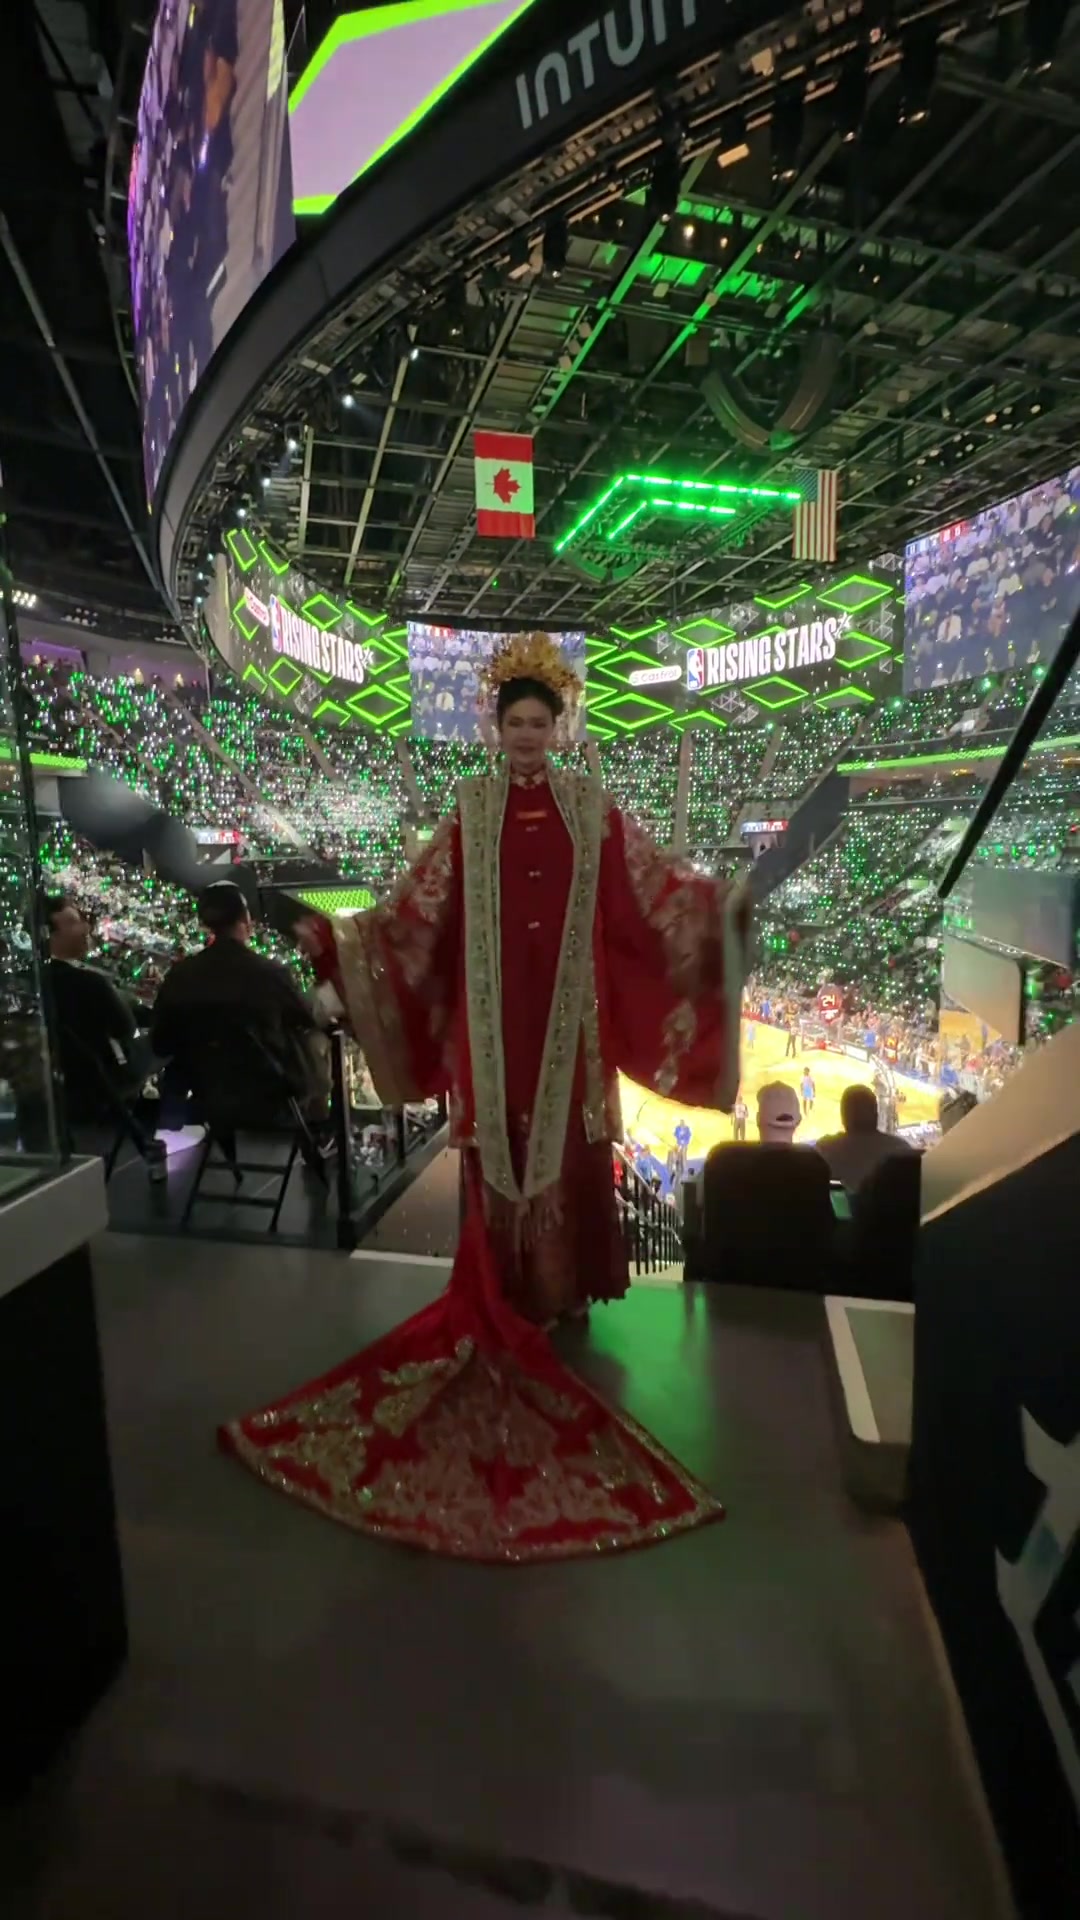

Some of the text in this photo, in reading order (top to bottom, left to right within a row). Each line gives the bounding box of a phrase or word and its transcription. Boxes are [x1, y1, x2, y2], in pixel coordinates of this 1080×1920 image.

[280, 604, 321, 670] RISING
[321, 630, 365, 683] STARS
[706, 617, 837, 686] RISING STARS
[821, 994, 836, 1007] 24
